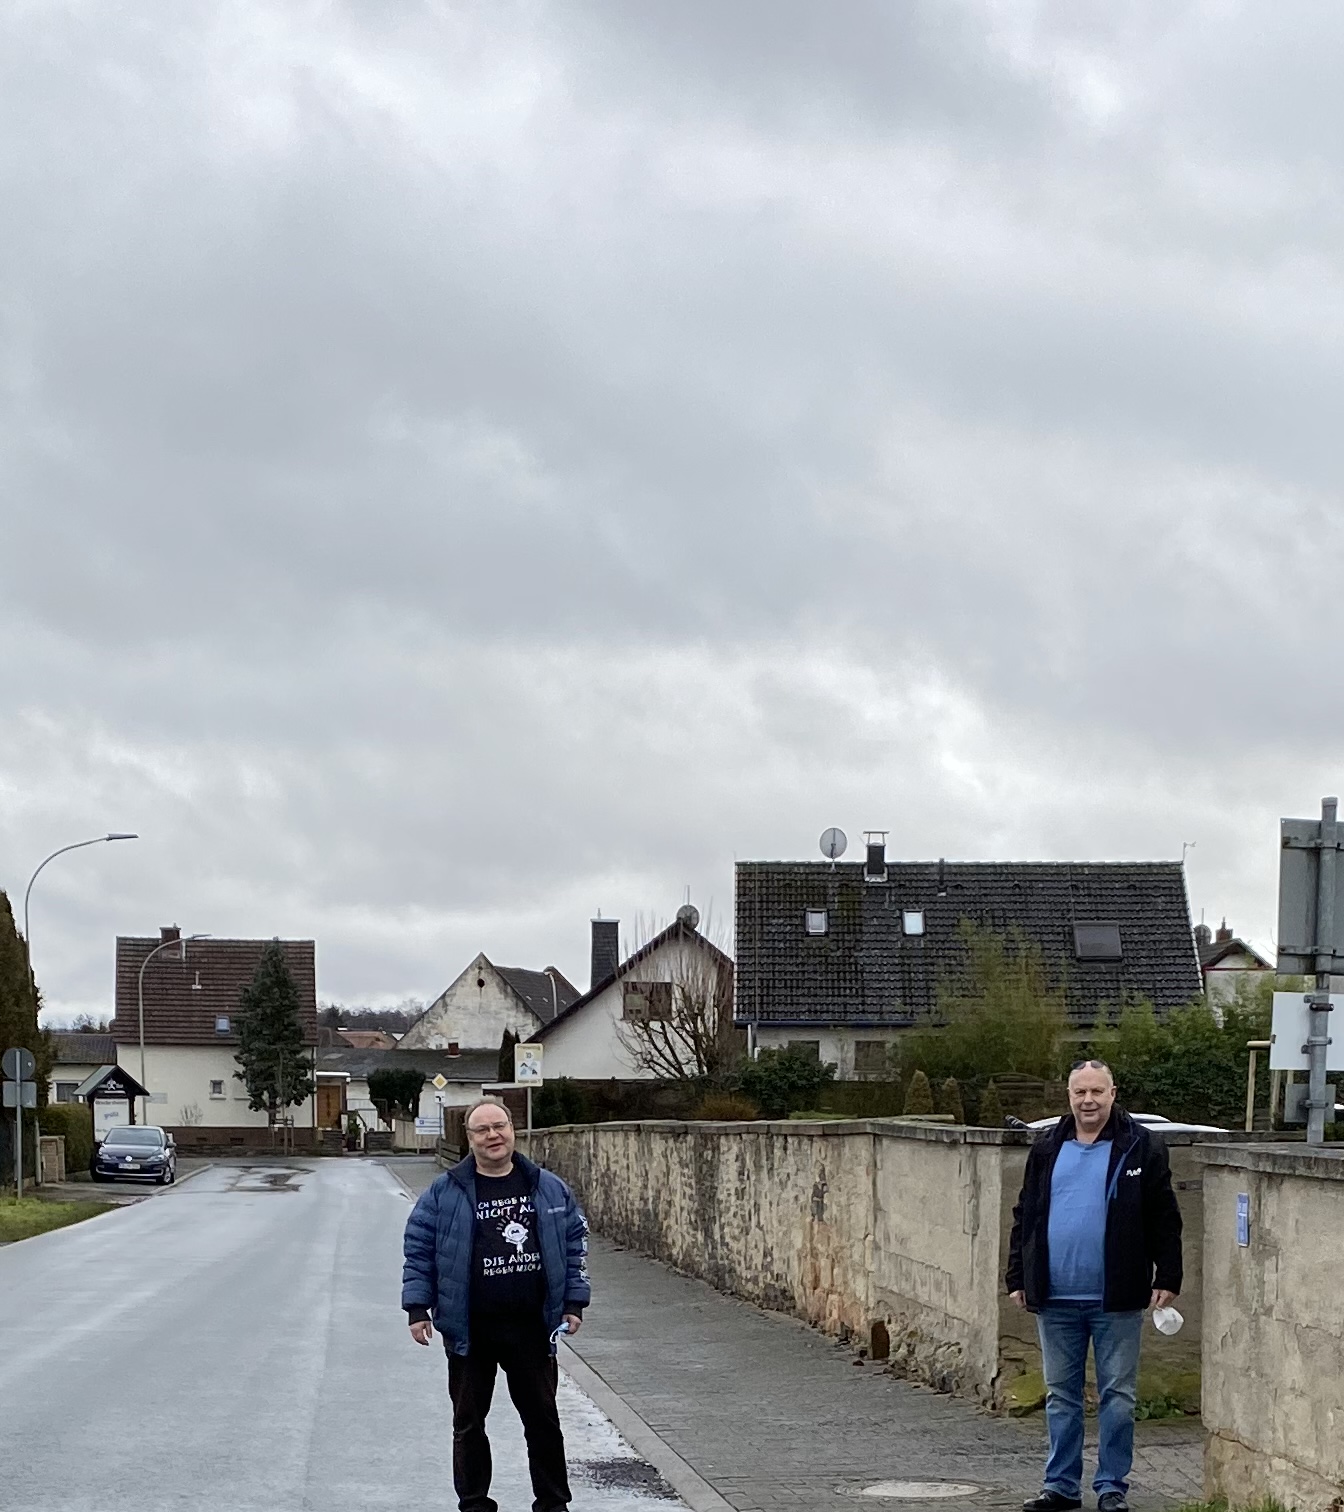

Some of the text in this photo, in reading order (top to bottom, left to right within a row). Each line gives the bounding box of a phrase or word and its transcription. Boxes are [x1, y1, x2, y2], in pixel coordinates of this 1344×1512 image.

[478, 1201, 489, 1210] CH
[483, 1256, 505, 1268] DIE
[483, 1265, 514, 1277] REGEN
